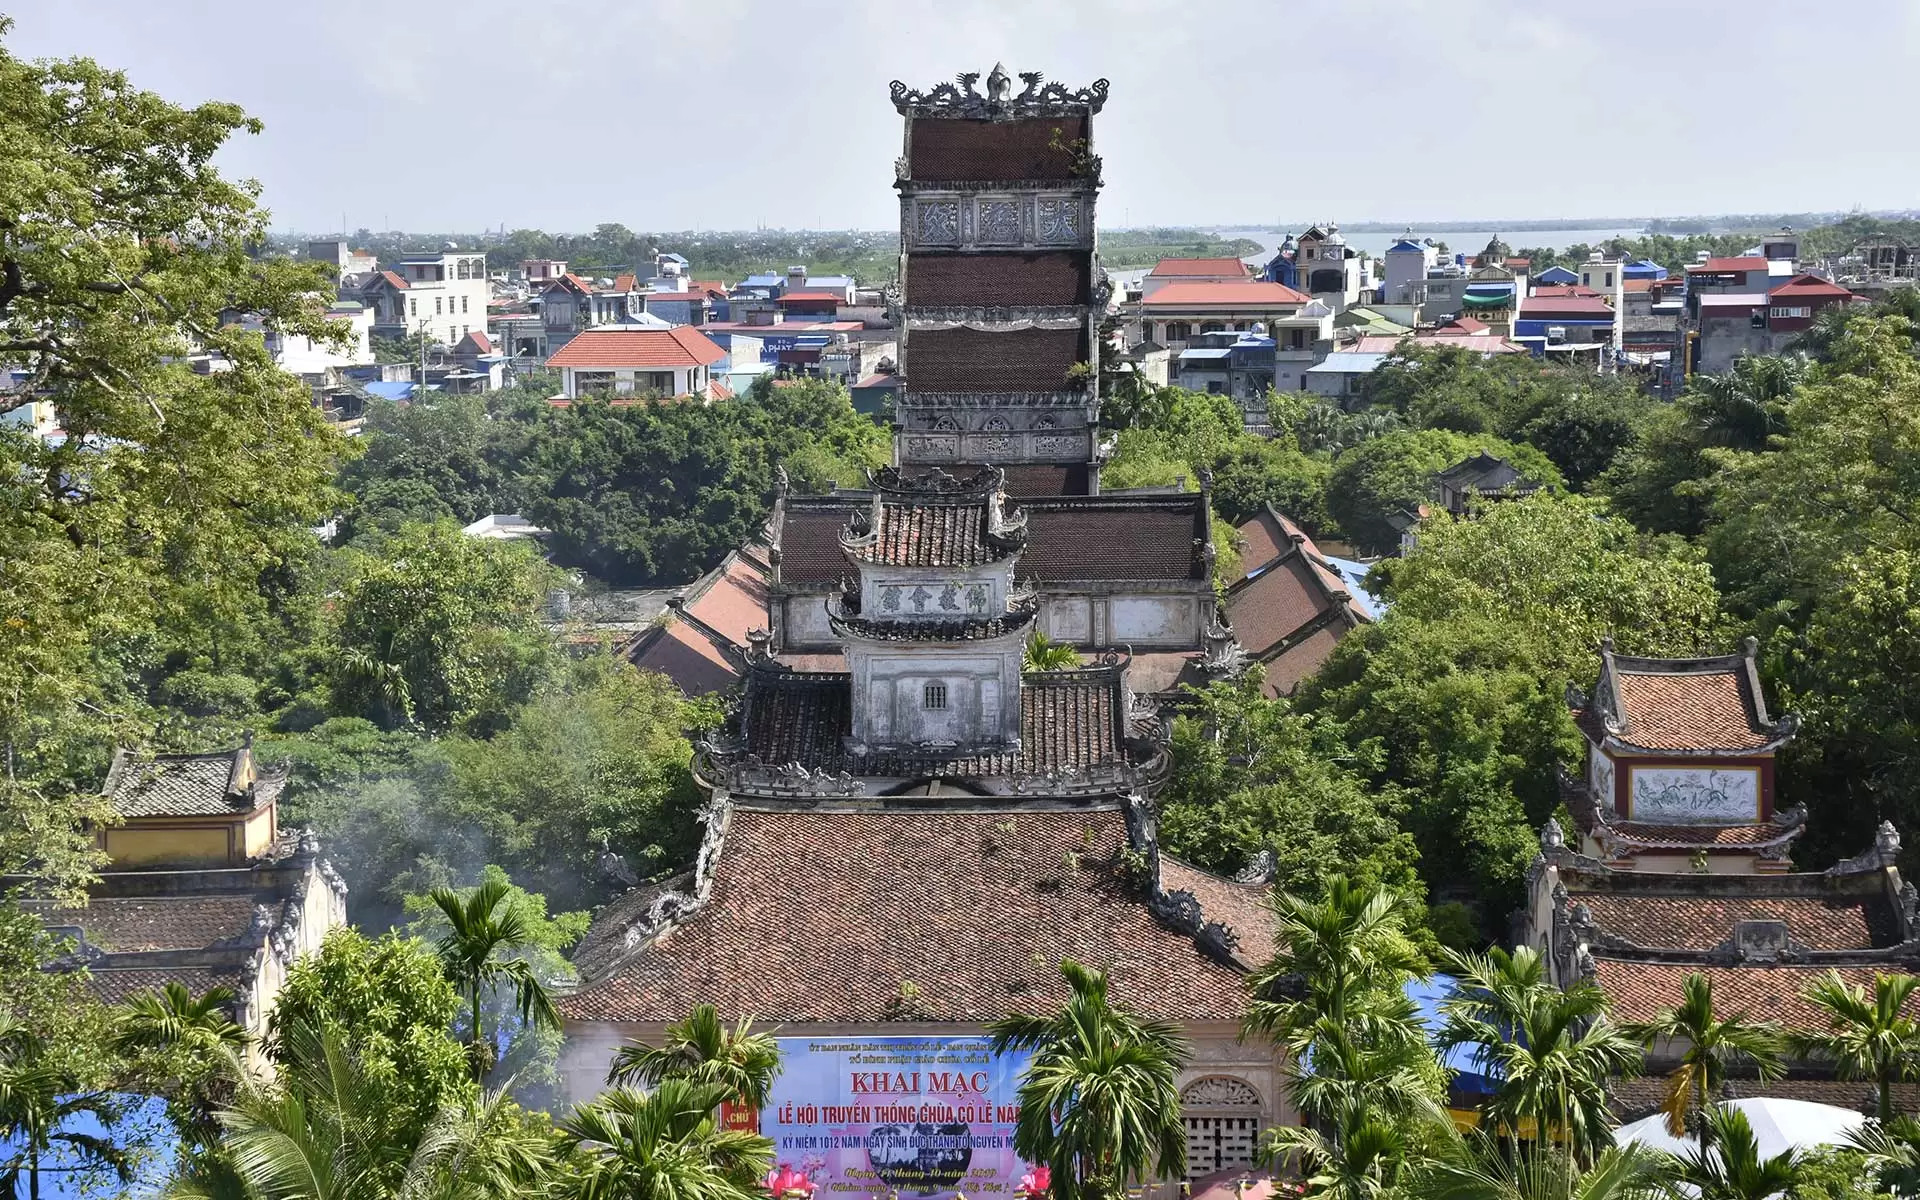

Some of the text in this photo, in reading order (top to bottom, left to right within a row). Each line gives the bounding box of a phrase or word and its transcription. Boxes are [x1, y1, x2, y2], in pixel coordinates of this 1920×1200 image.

[850, 1071, 990, 1098] KHAI MẠC
[778, 1100, 793, 1124] LỄ
[796, 1103, 818, 1128] HỘI
[874, 1100, 917, 1124] THỐNG
[920, 1102, 955, 1123] CHÙA
[957, 1100, 975, 1123] CỔ
[979, 1099, 993, 1123] LỄ
[795, 1134, 817, 1152] NIỆM
[820, 1136, 839, 1149] 1012
[841, 1134, 861, 1149] NĂM
[863, 1133, 885, 1149] NGÀY
[887, 1136, 907, 1149] SINH
